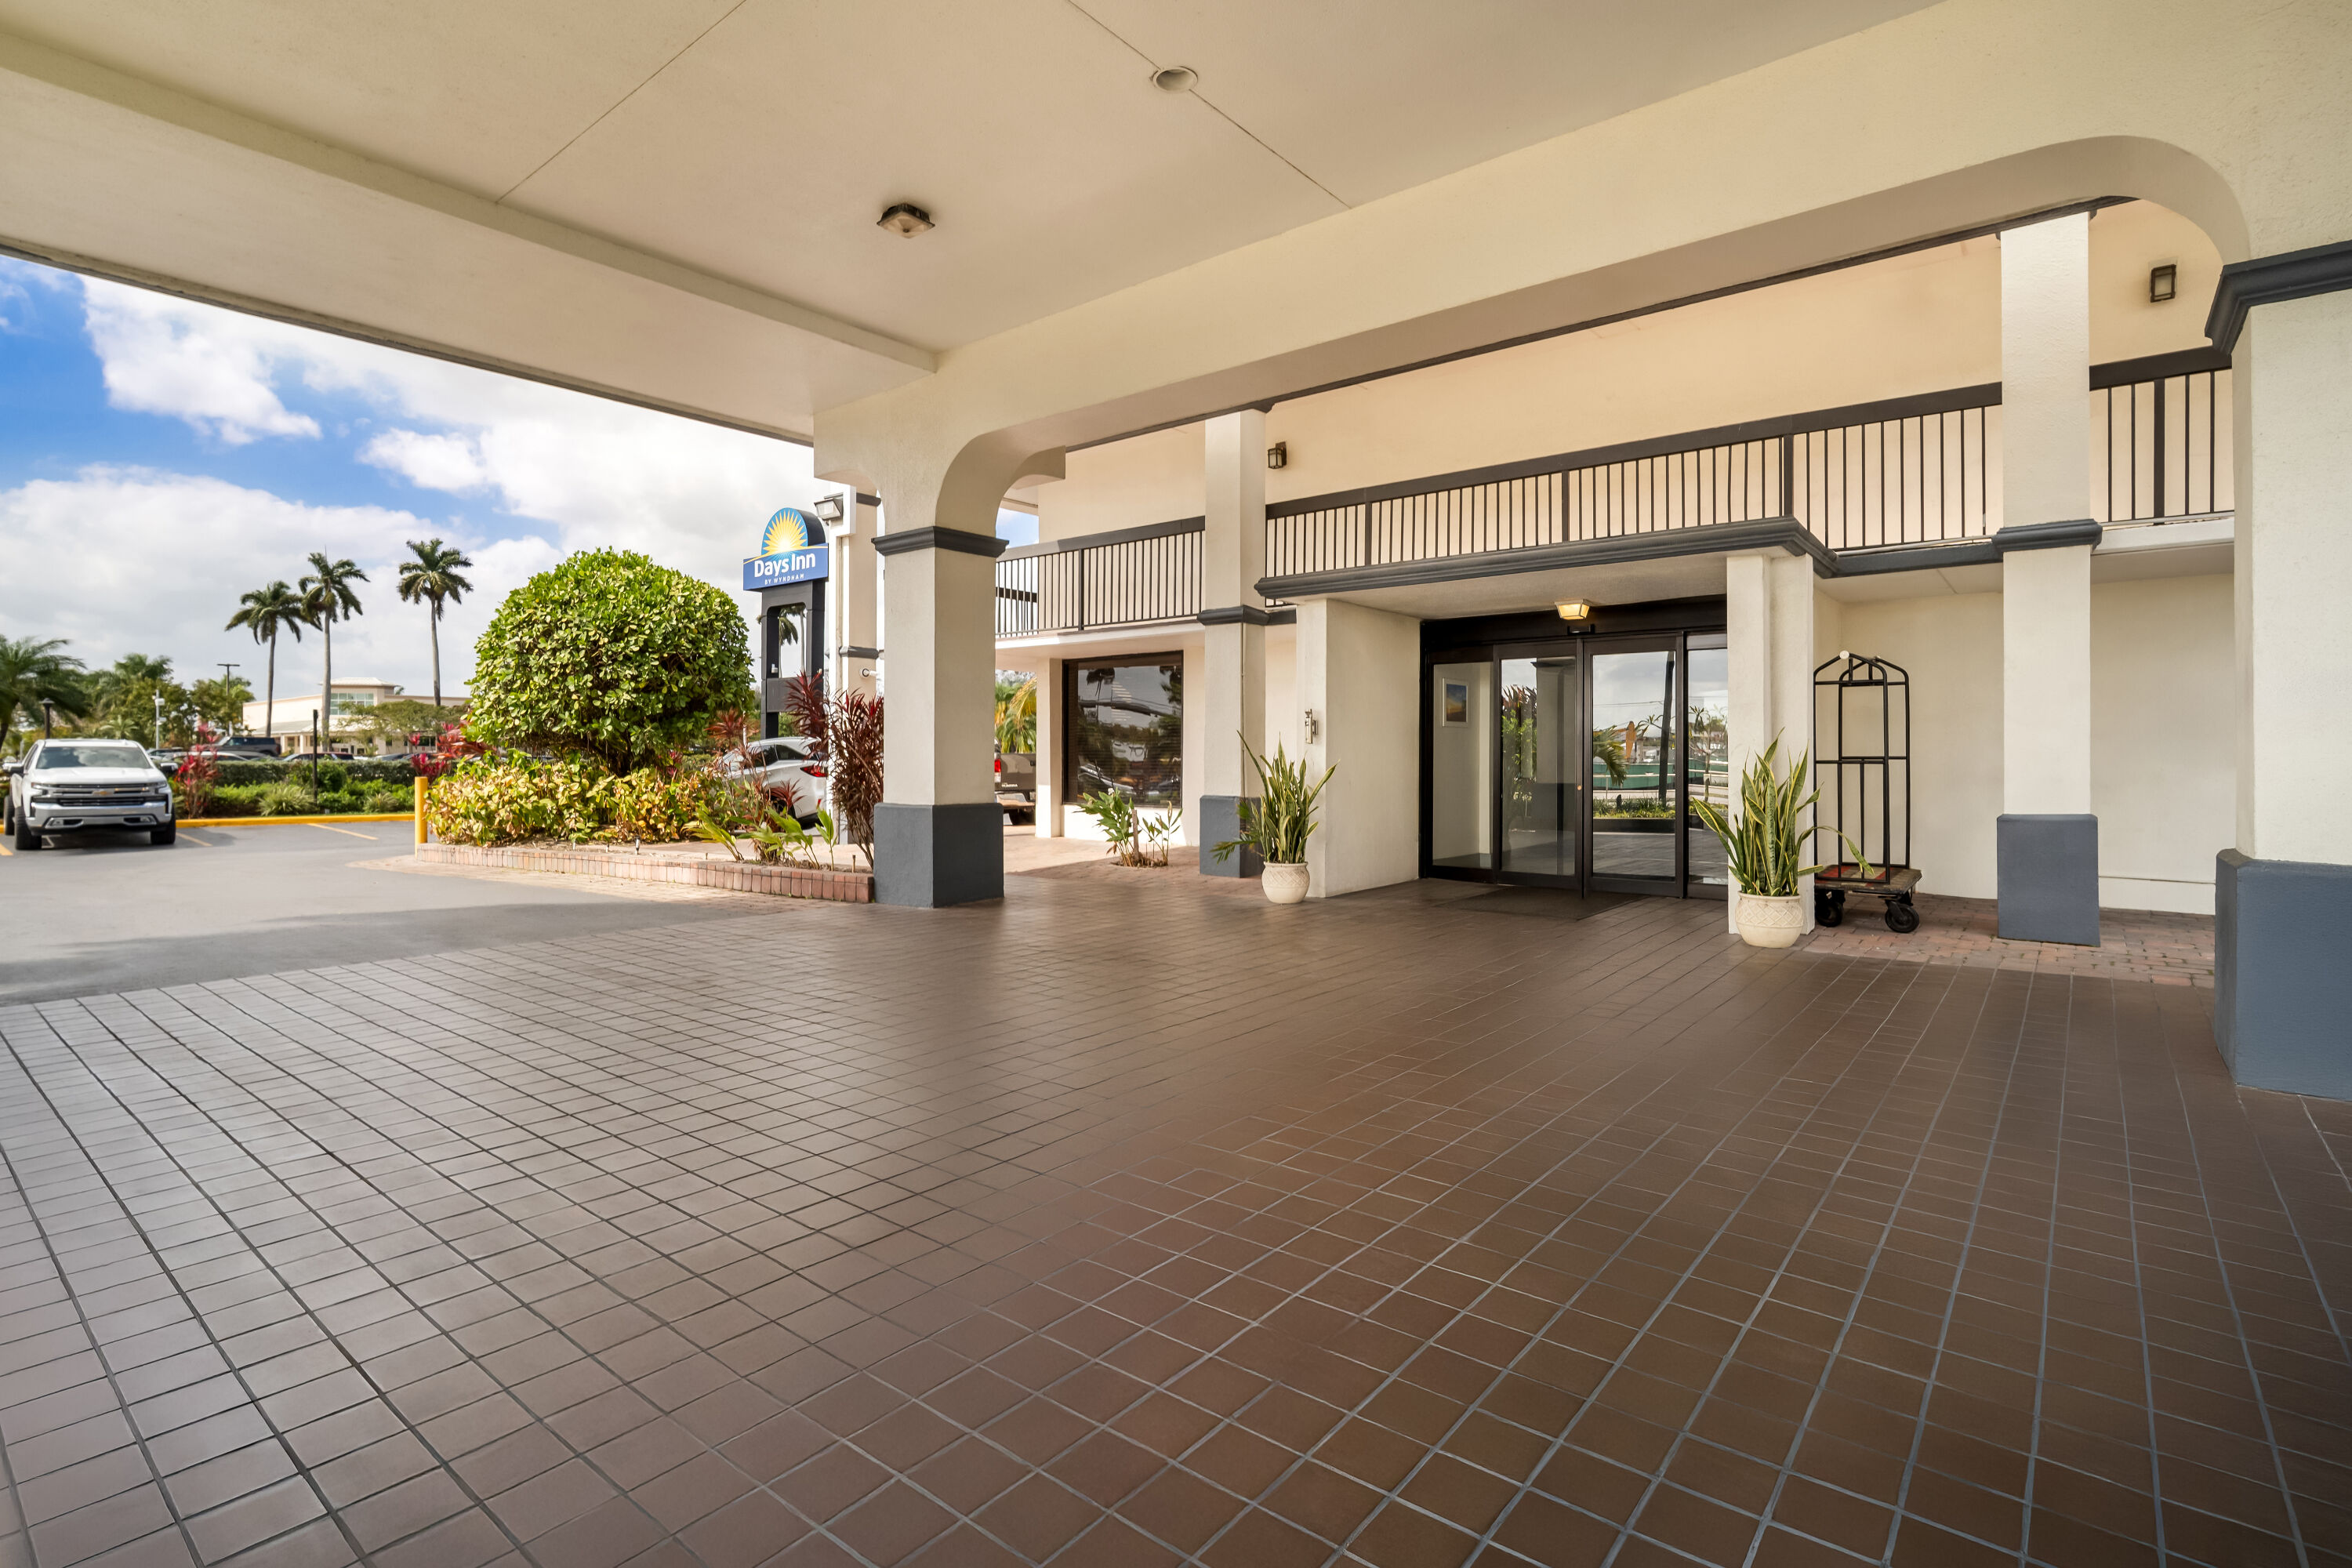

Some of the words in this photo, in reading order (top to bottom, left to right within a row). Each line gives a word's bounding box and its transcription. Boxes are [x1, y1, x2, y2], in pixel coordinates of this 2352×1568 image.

[754, 558, 789, 577] Days
[791, 554, 815, 571] Inn
[774, 573, 804, 583] WYNDHAM
